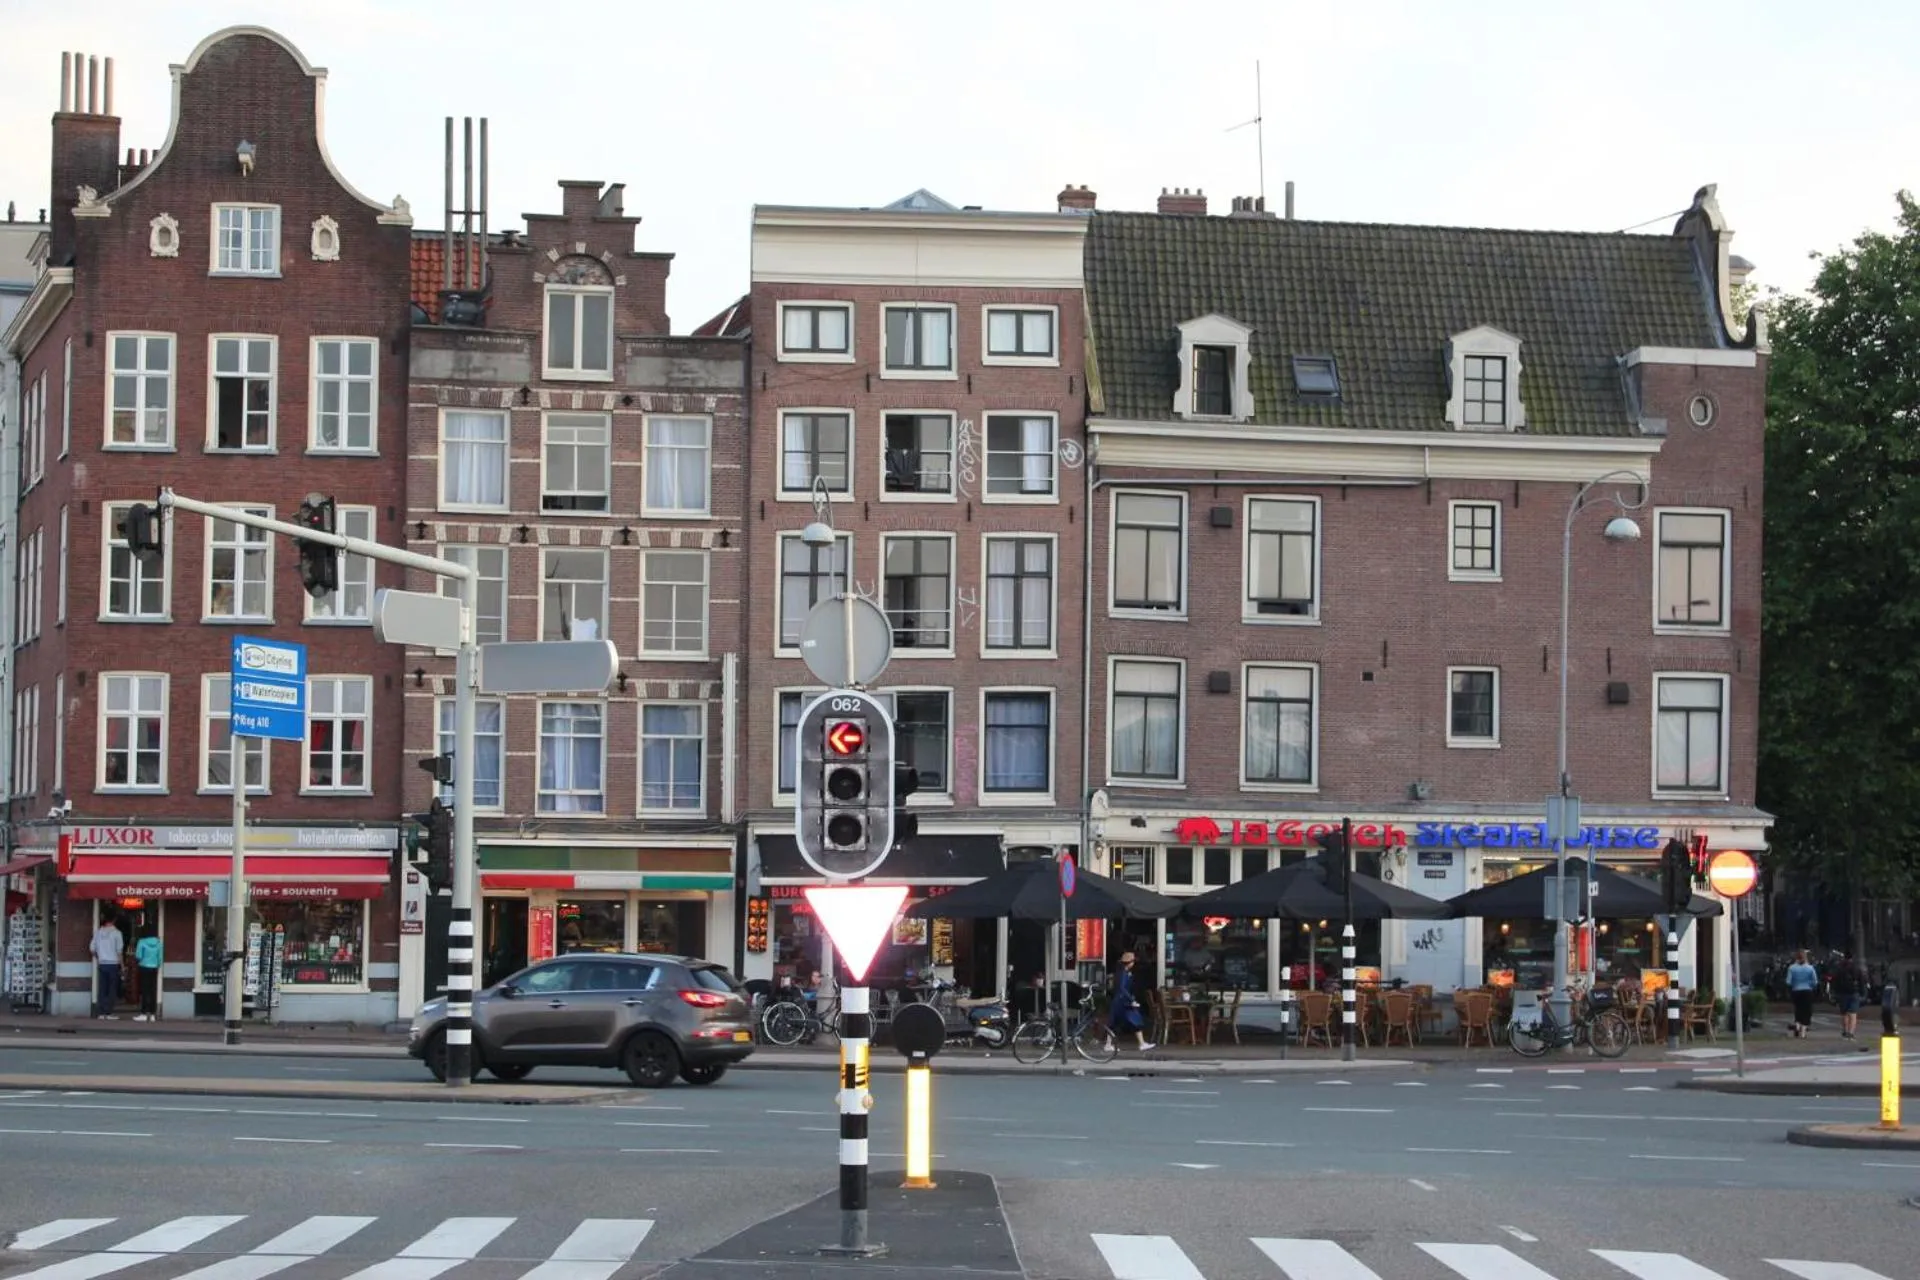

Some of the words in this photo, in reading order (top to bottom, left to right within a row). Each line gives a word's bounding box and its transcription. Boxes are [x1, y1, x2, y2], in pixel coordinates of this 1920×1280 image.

[831, 697, 861, 712] 062
[73, 827, 154, 845] LUXOR
[168, 829, 209, 843] tobacco
[116, 885, 162, 896] tobacco
[165, 885, 193, 897] shop
[282, 886, 338, 896] souvenirs
